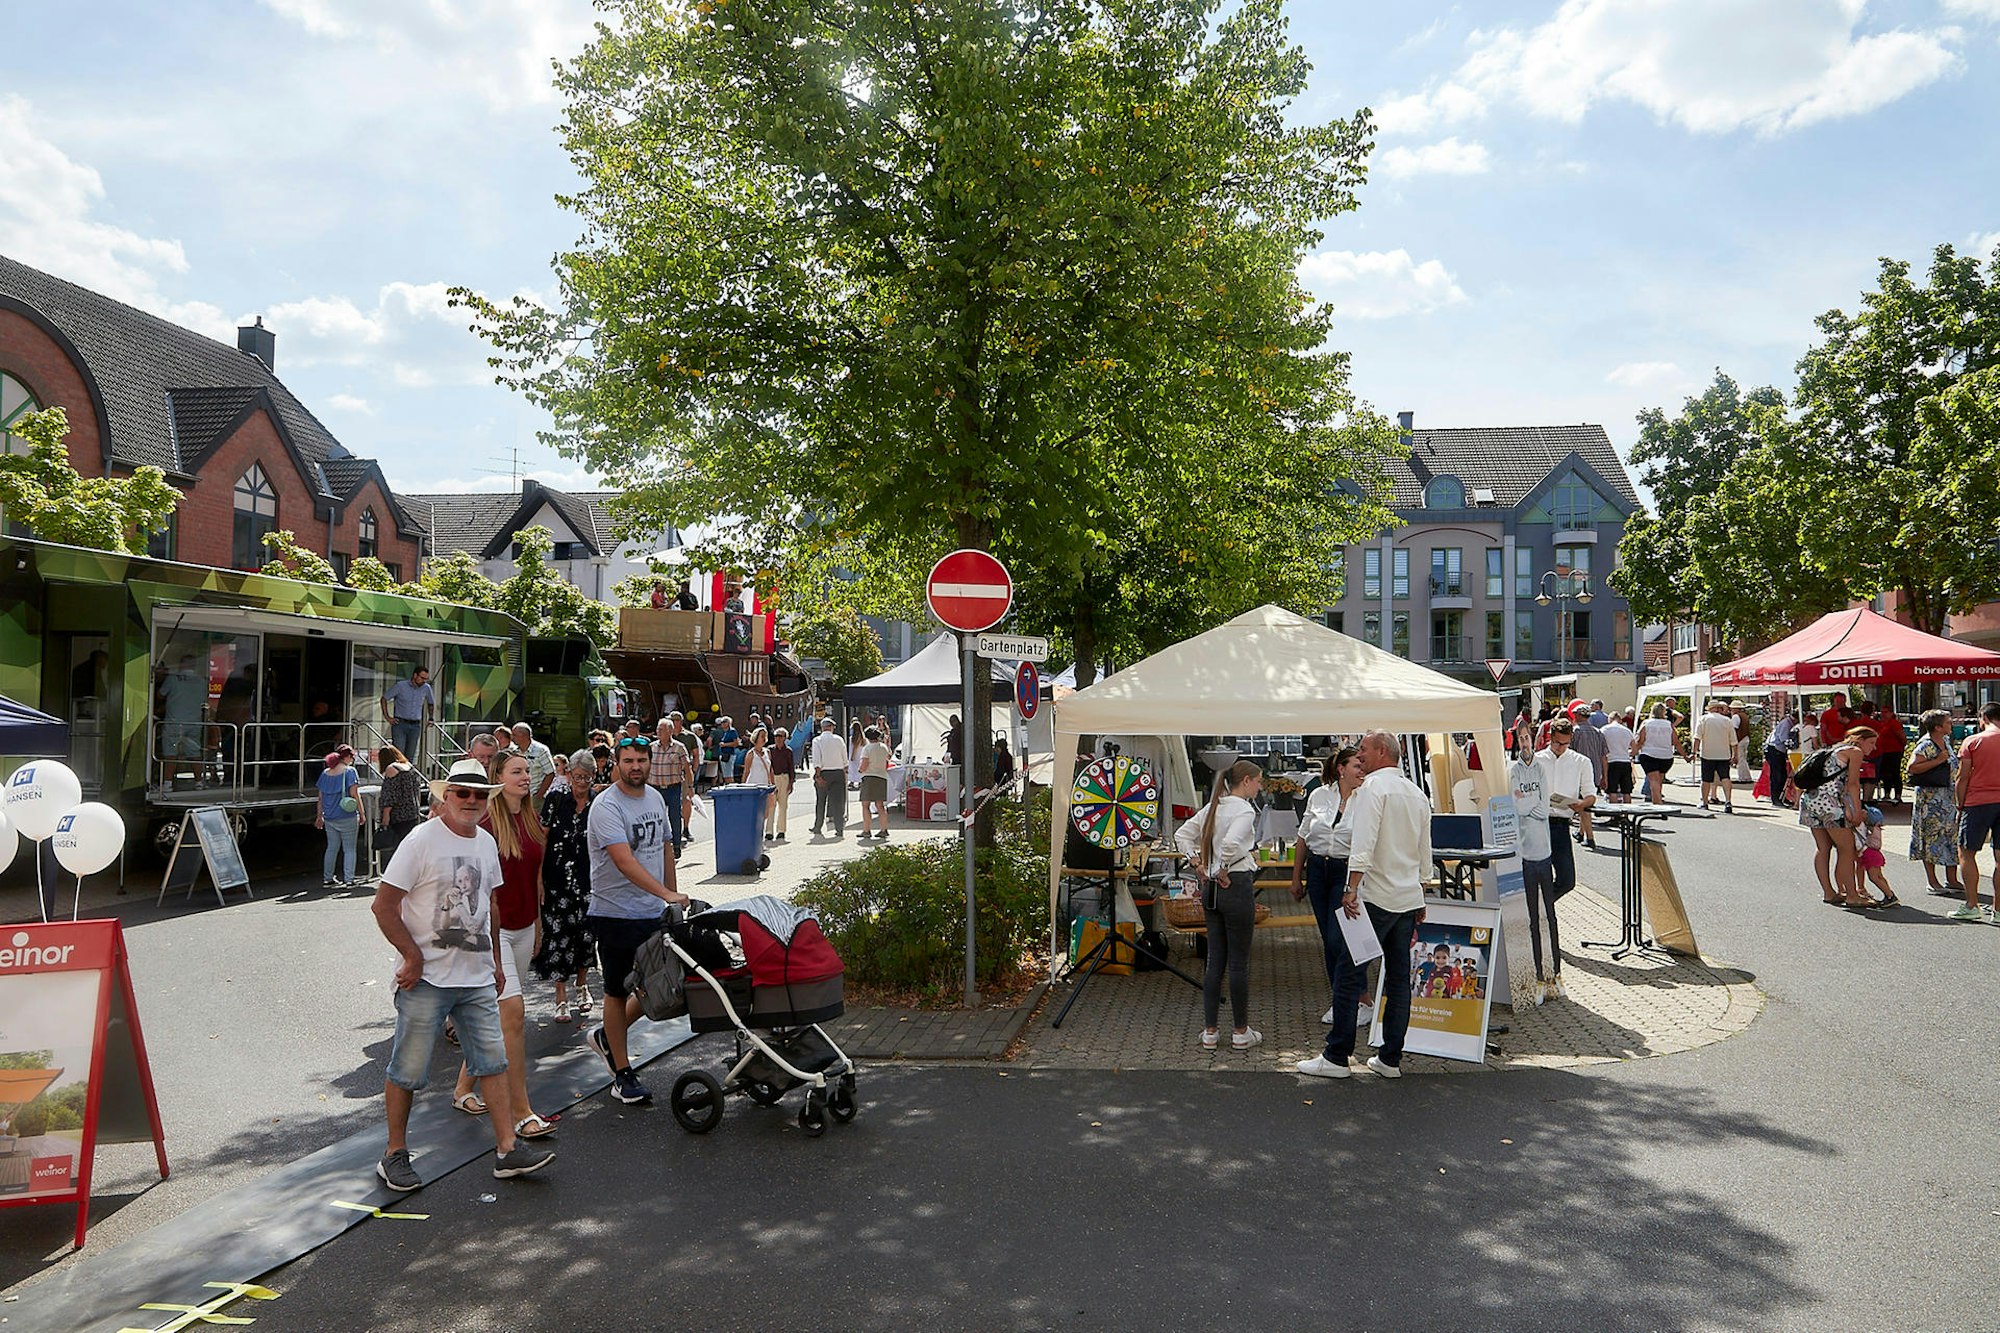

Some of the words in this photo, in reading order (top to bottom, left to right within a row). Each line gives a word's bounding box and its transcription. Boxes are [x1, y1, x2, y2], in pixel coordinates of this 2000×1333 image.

[980, 638, 1044, 657] Gartenplatz
[1914, 666, 1952, 675] hören
[1956, 666, 1966, 675] &
[1970, 666, 2000, 675] sehe
[7, 791, 42, 804] HANSEN
[0, 931, 75, 968] einor
[35, 1163, 68, 1177] weinor
